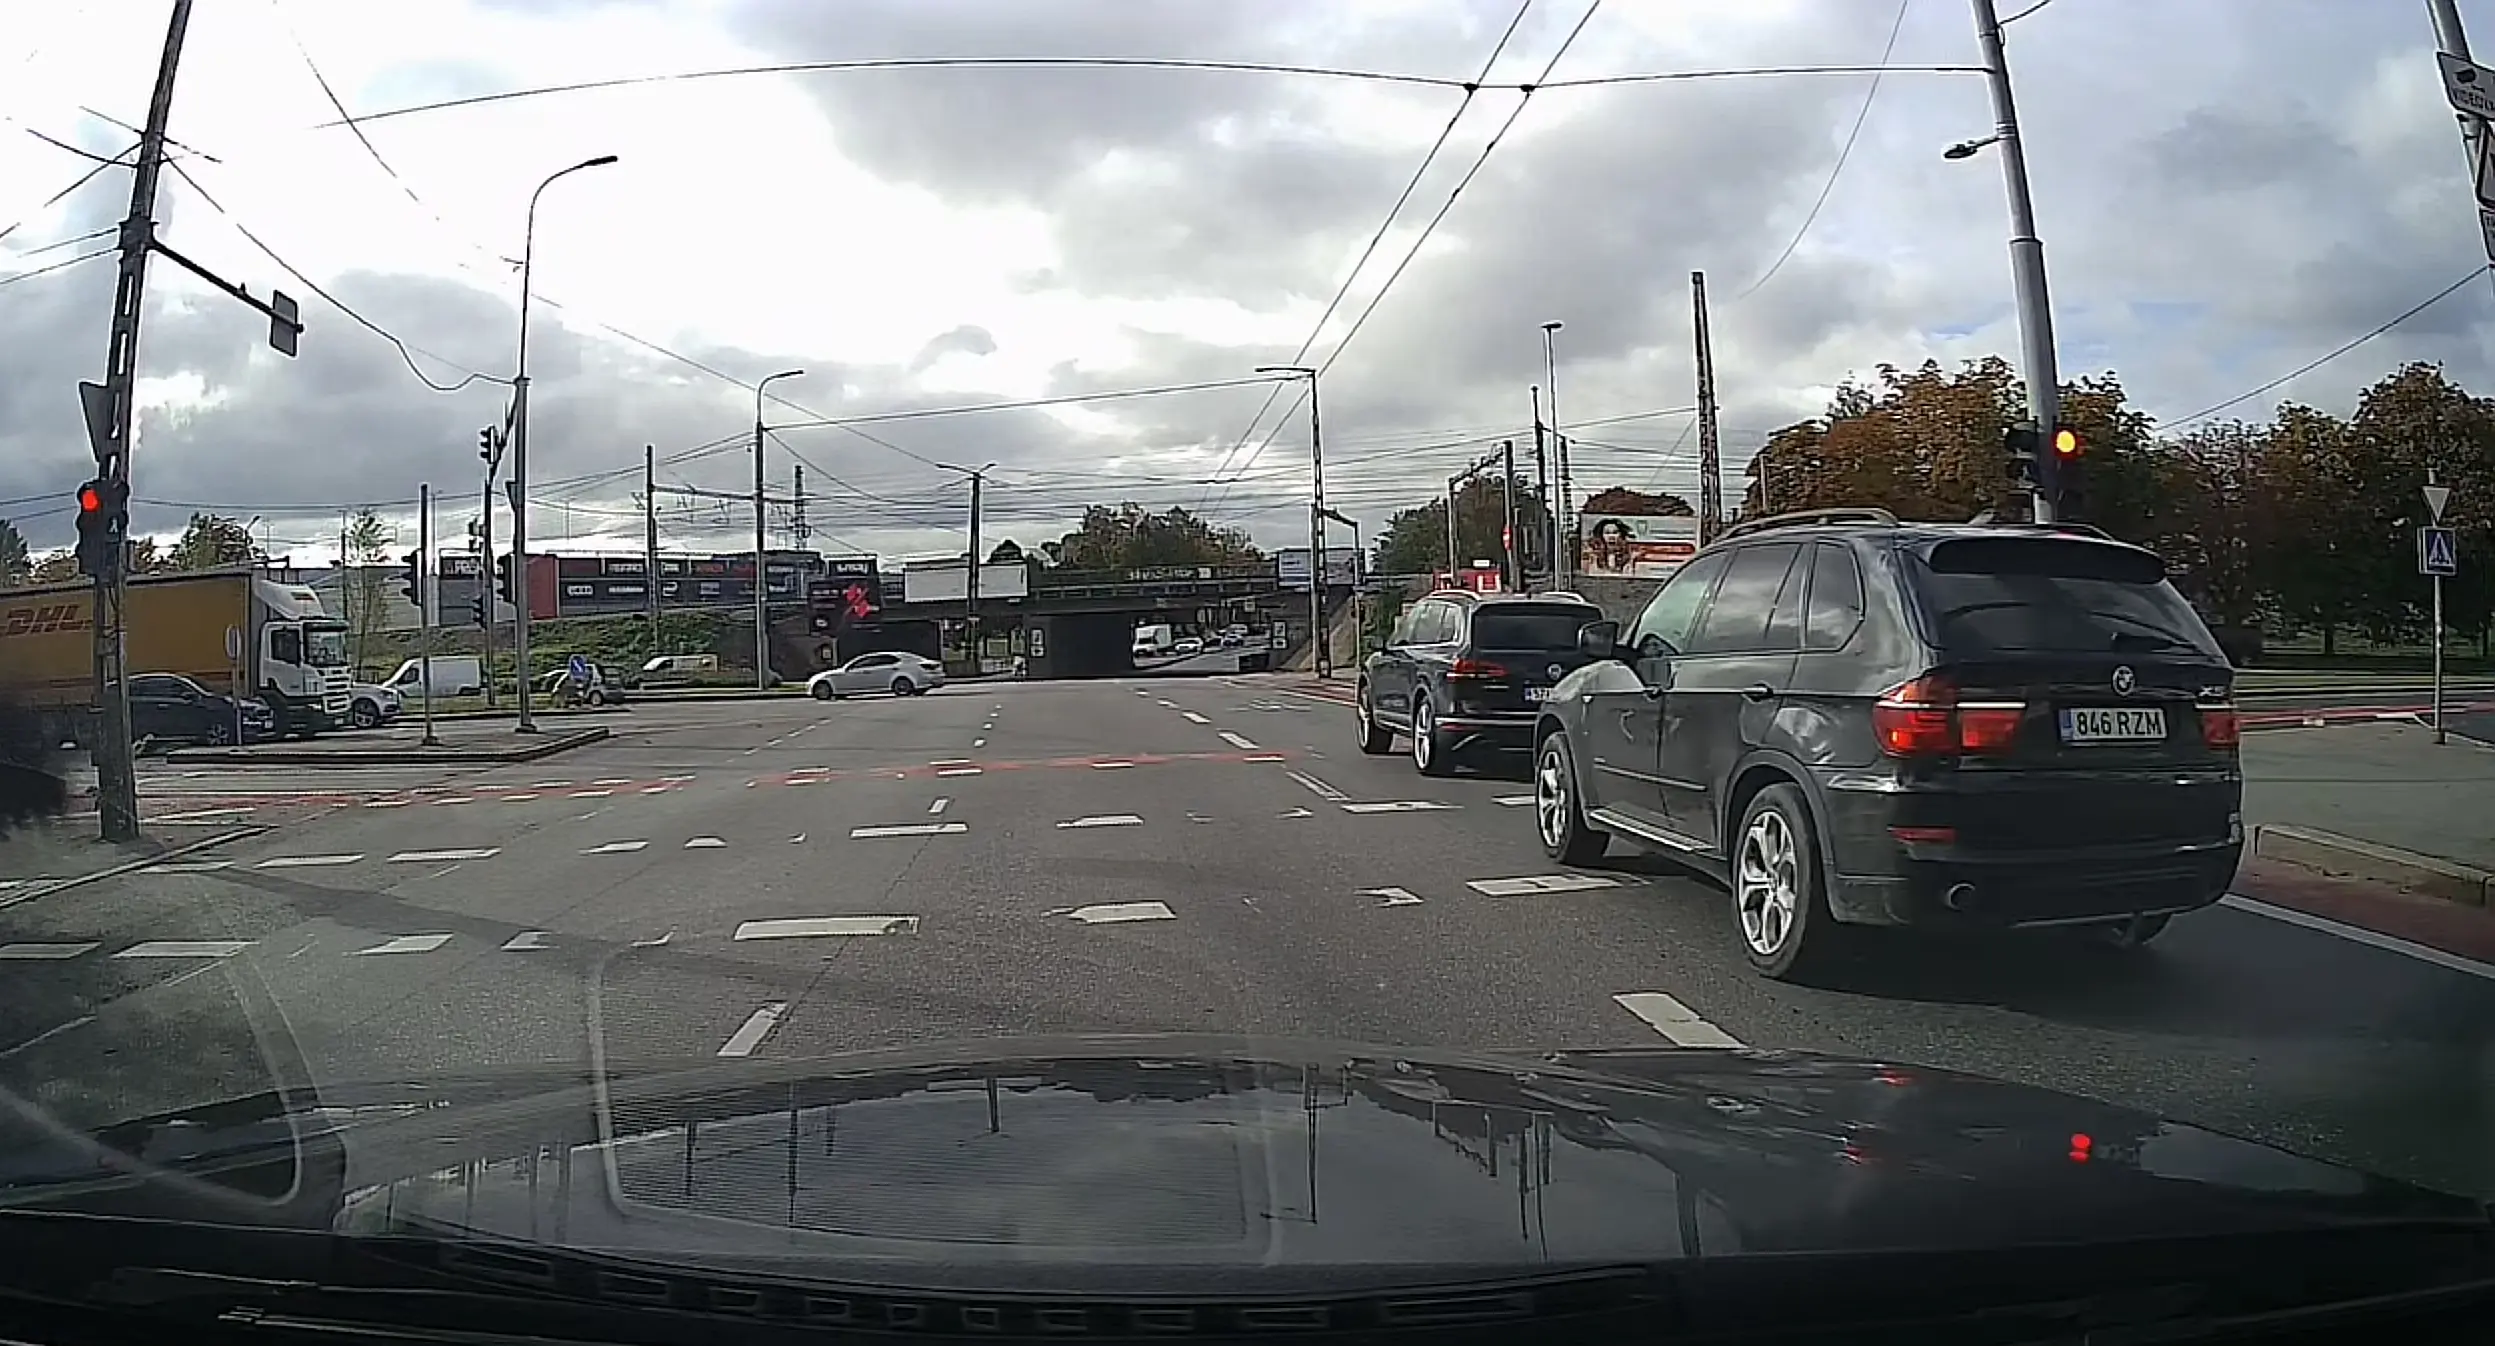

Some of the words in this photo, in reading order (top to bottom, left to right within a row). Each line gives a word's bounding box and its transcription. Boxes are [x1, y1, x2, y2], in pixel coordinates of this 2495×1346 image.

[6, 605, 82, 634] DHL
[2076, 711, 2112, 736] 846
[2117, 711, 2162, 736] RZM
